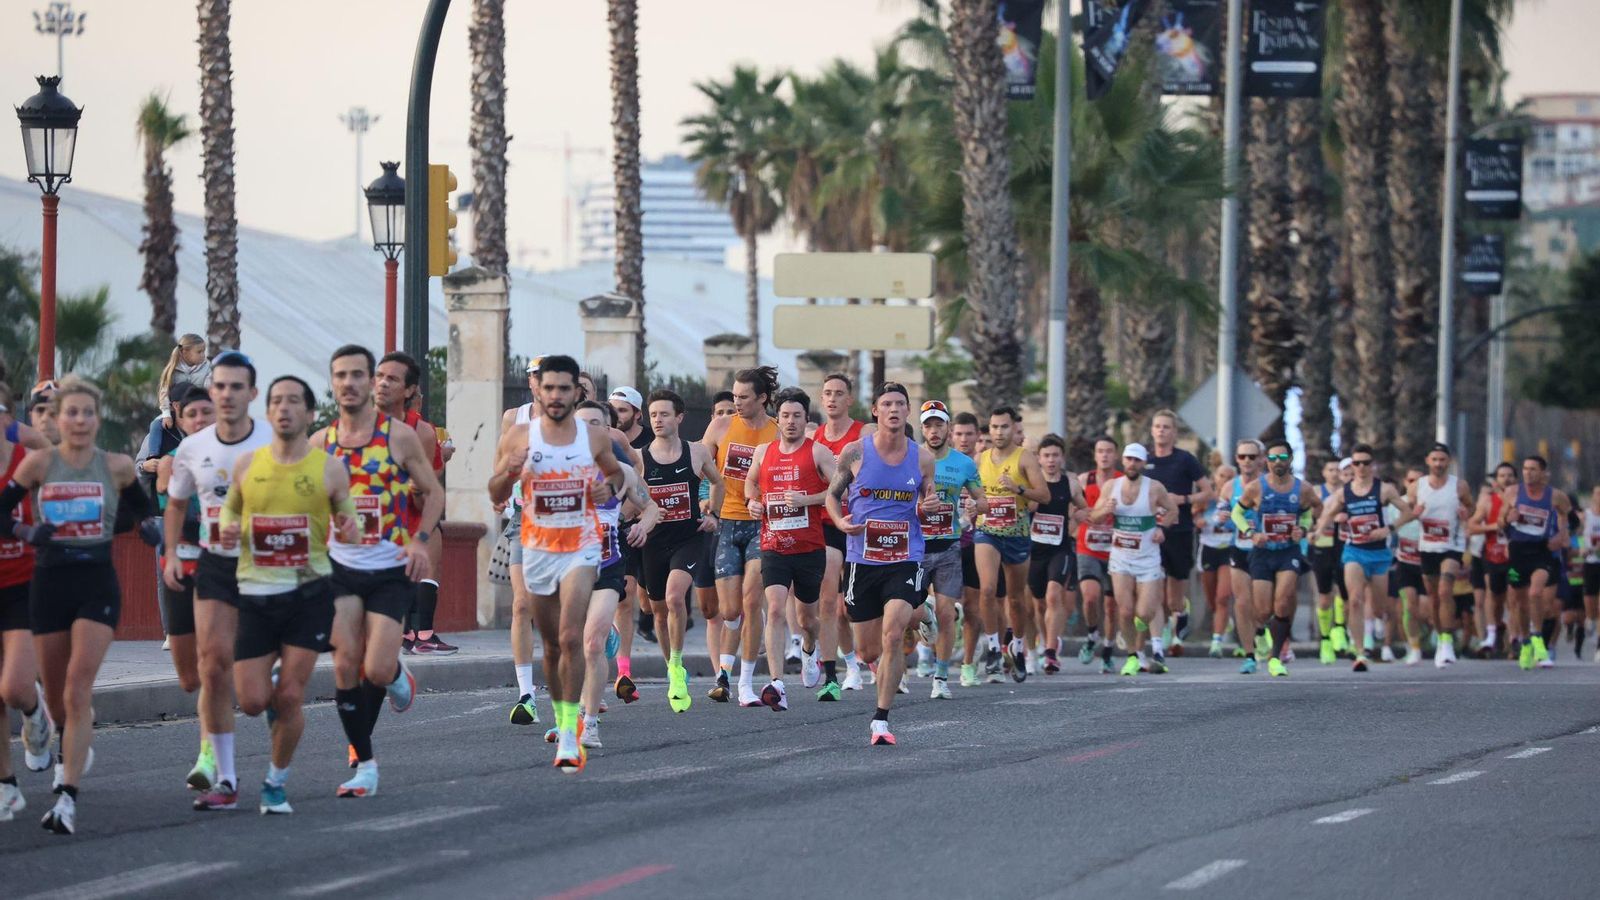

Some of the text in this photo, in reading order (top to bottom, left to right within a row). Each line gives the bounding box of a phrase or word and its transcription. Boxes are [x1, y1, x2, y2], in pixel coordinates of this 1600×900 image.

[873, 489, 892, 500] YOU
[543, 496, 576, 507] 12388
[660, 496, 680, 506] 1983
[877, 535, 898, 544] 4963
